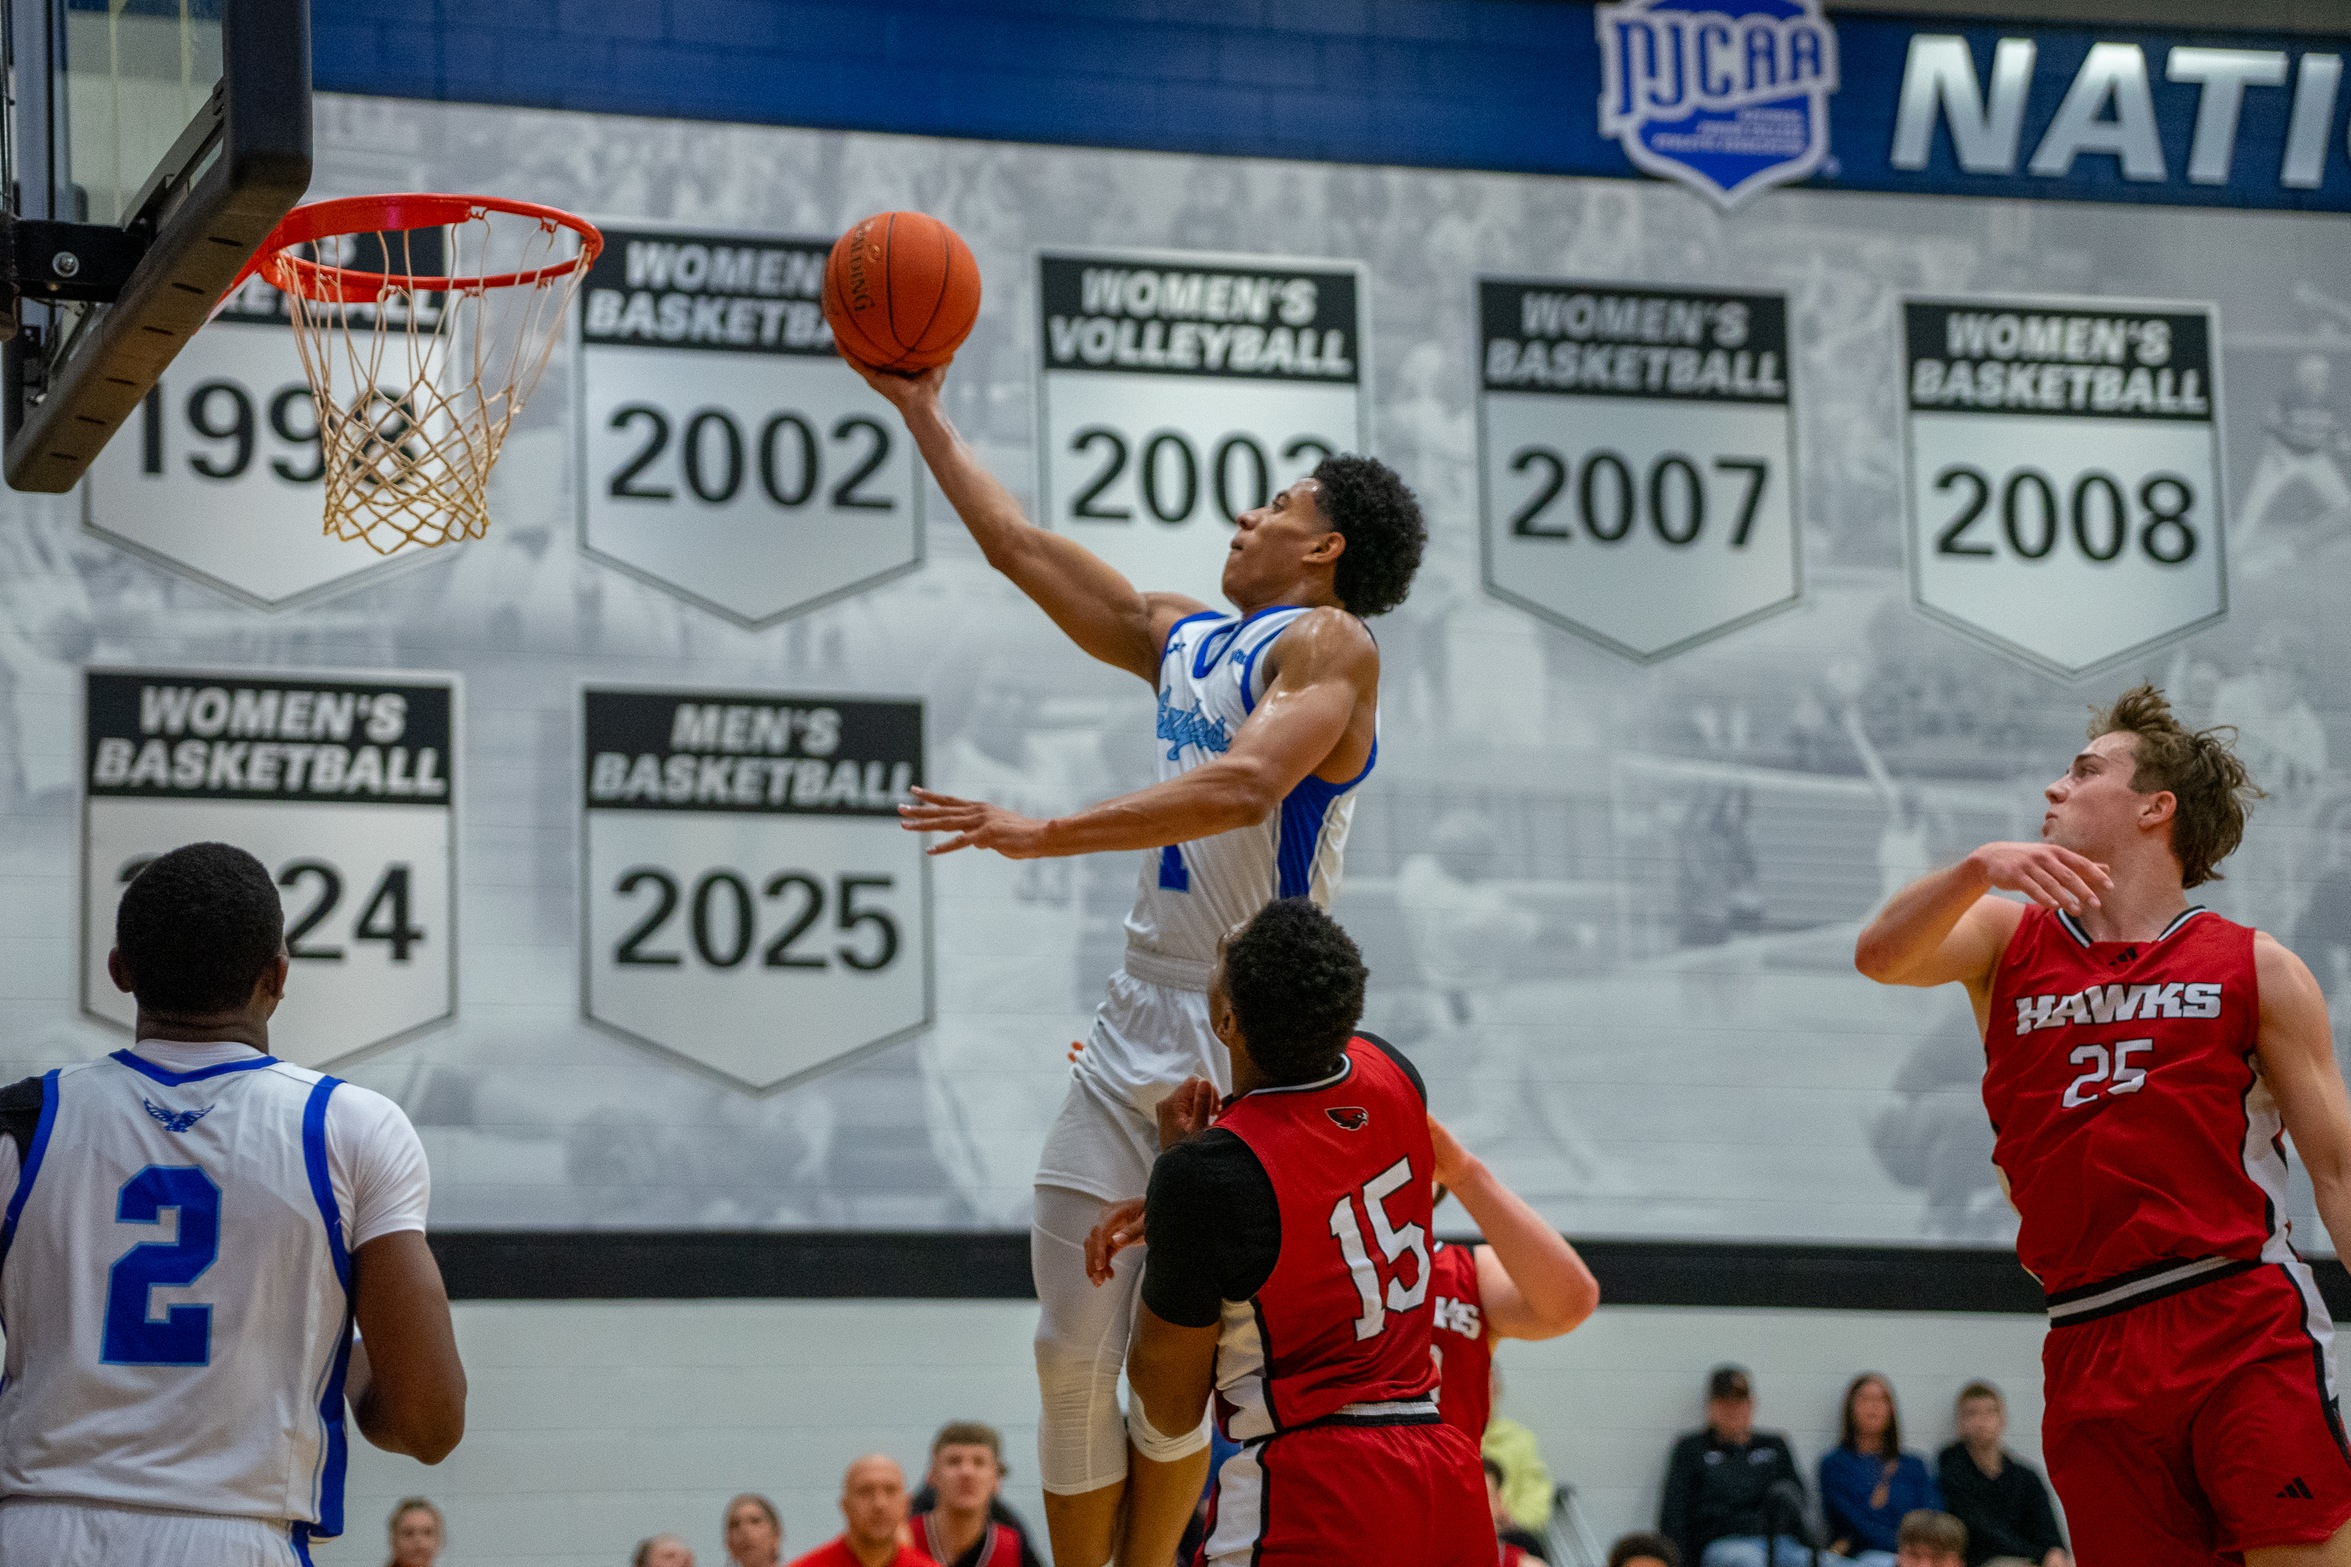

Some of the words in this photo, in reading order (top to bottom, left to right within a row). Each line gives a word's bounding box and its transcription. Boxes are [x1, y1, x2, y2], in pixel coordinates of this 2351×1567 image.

[1612, 18, 1826, 117] NJCAA
[1892, 34, 2351, 187] NATI
[625, 241, 828, 295] WOMEN
[1082, 270, 1317, 324] WOMEN'S
[584, 288, 833, 347] BASKETB
[1049, 317, 1351, 375] VOLLEYBALL
[1521, 292, 1749, 346] WOMEN'S
[1947, 313, 2171, 365] WOMEN'S
[1484, 338, 1785, 396] BASKETBALL
[1911, 358, 2206, 413] BASKETBALL
[608, 402, 896, 508] 2002
[1509, 446, 1770, 549] 2007
[1934, 465, 2200, 568] 2008
[140, 686, 408, 743] WOMEN'S
[670, 703, 842, 756] MEN'S
[93, 738, 446, 796] BASKETBALL
[590, 752, 914, 804] BASKETBALL
[612, 866, 902, 974] 2025
[2015, 981, 2222, 1036] HAWKS
[2061, 1038, 2154, 1109] 25
[99, 1164, 223, 1367] 2
[1328, 1153, 1432, 1342] 15
